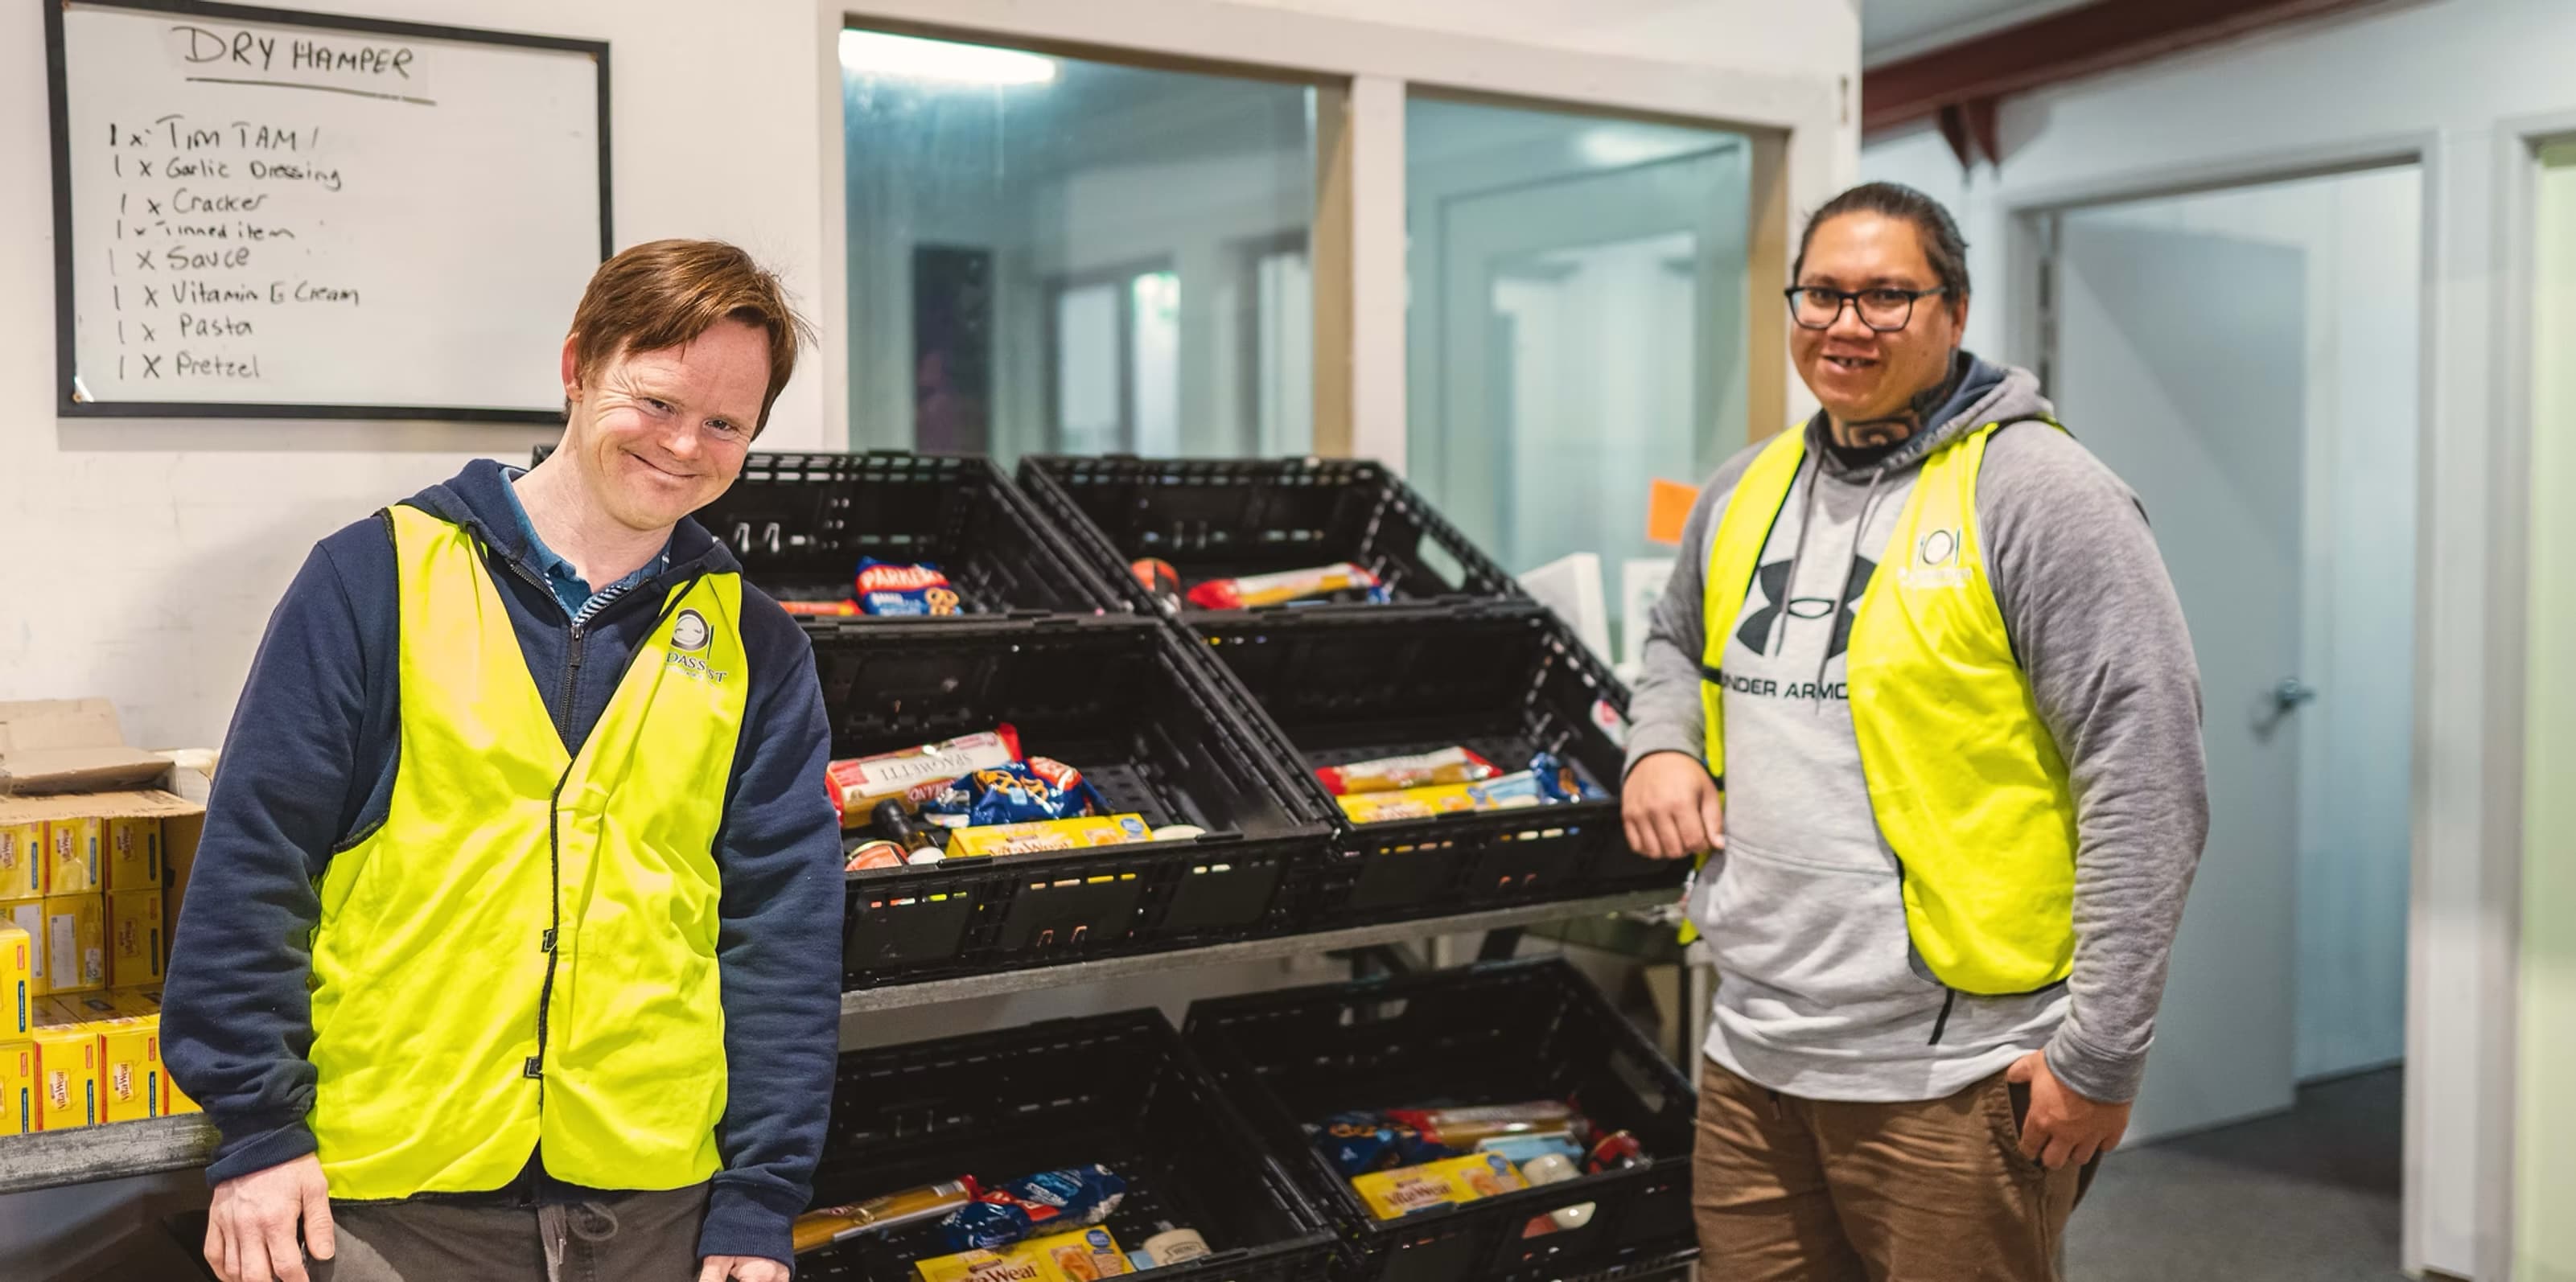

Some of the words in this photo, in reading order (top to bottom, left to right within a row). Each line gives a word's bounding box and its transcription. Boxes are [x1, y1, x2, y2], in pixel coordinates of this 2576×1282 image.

[171, 24, 278, 71] DRY
[292, 39, 414, 79] HAMPER
[166, 157, 228, 179] Garlic
[173, 187, 267, 213] Cracker
[167, 245, 249, 270] Sauce
[172, 281, 258, 304] Vitamin
[294, 281, 359, 306] Cream
[180, 313, 253, 337] Pasta
[176, 351, 259, 378] Pretzel
[1723, 673, 1776, 697] NDER
